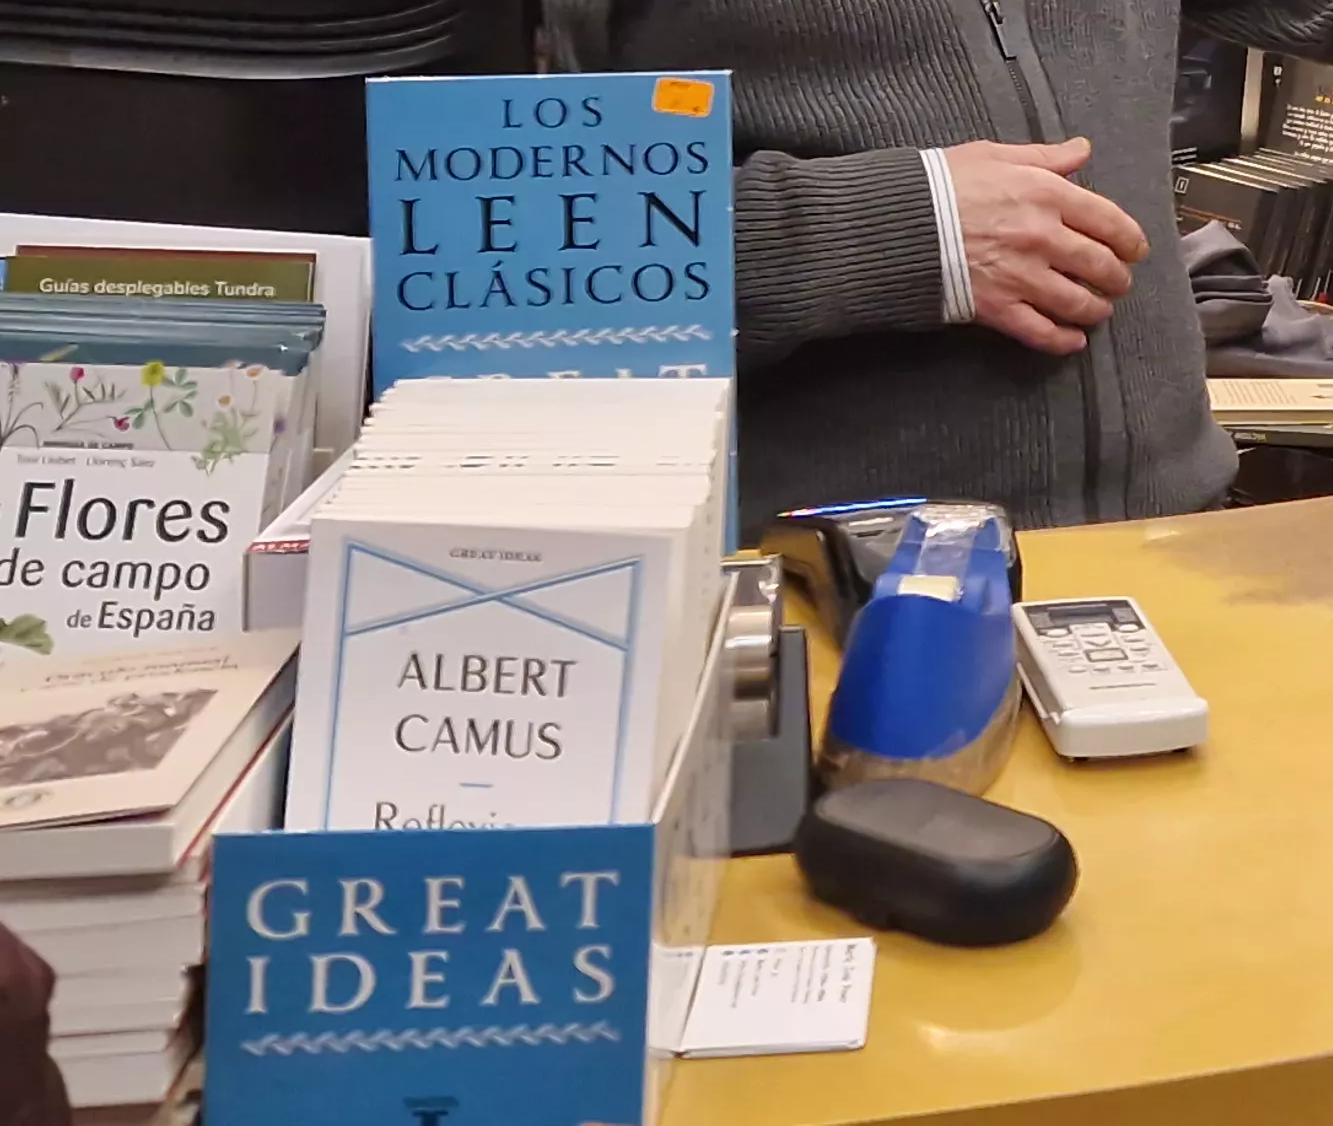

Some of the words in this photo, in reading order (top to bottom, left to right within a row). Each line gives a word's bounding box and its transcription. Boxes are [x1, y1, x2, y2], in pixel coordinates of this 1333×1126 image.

[501, 96, 606, 130] LOS
[394, 140, 711, 183] MODERNOS
[398, 189, 708, 256] LEEN
[39, 277, 90, 295] Guías
[93, 279, 210, 298] desplegables
[214, 280, 276, 298] Tundra
[396, 259, 712, 312] CLÁSICOS
[15, 478, 231, 544] Flores
[0, 547, 45, 587] de
[61, 560, 211, 602] campo
[66, 610, 92, 629] de
[97, 601, 217, 639] España
[396, 651, 579, 699] ALBERT
[394, 713, 564, 761] CAMUS
[245, 869, 621, 942] GREAT
[244, 942, 618, 1016] IDEAS
